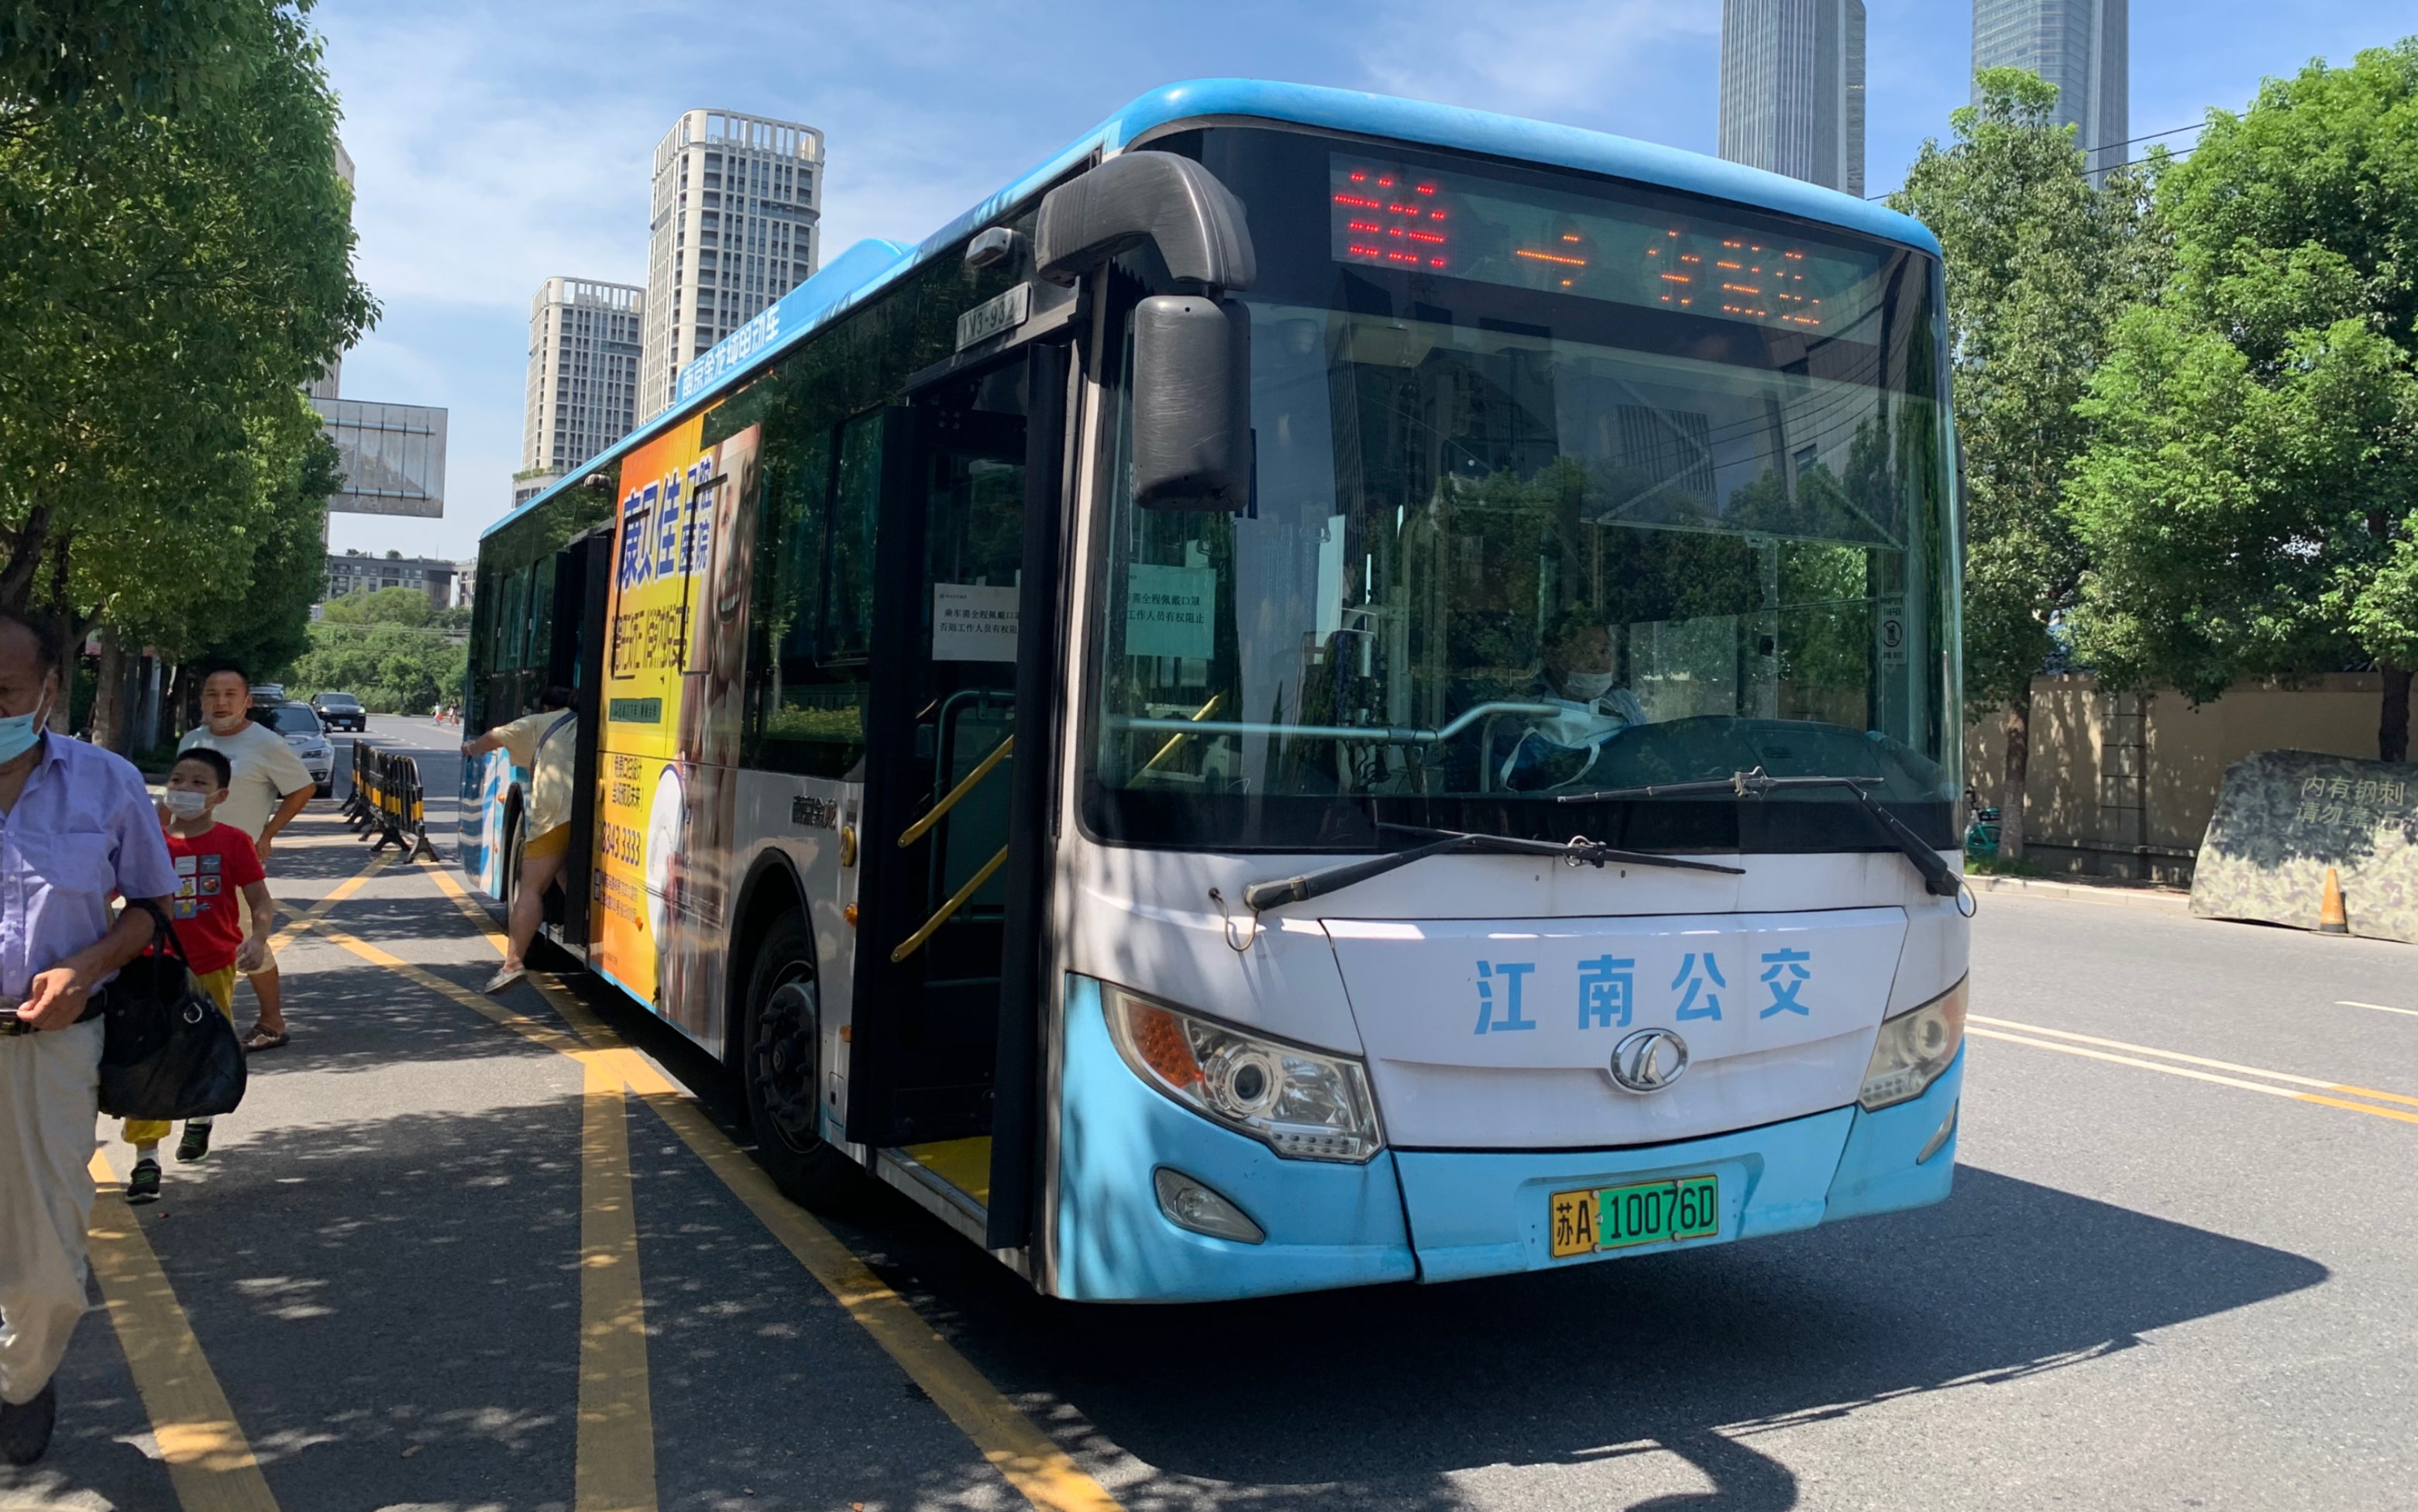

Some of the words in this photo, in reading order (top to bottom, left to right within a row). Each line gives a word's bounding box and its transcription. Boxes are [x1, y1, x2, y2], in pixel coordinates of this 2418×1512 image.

[682, 304, 780, 400] 南京金龙纯电动车
[685, 459, 713, 516] 口腔
[616, 471, 680, 590] 康贝佳
[678, 520, 710, 572] 医院
[2296, 801, 2401, 830] 请勿靠近
[2301, 774, 2406, 806] 内有钢刺
[1473, 947, 1811, 1035] 江南公交
